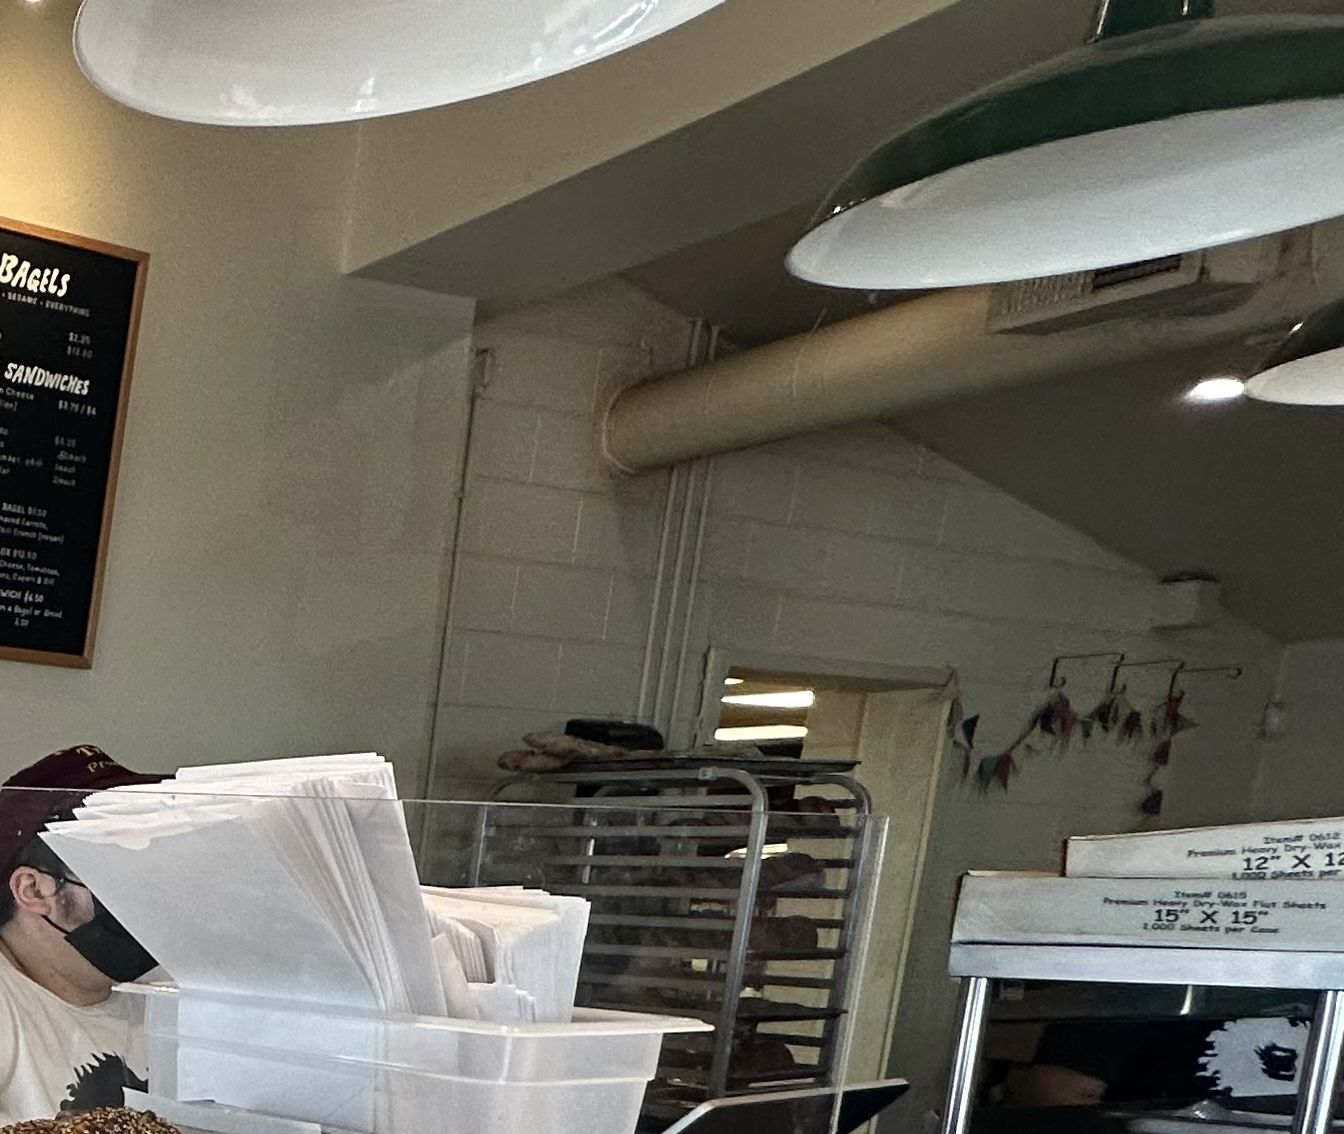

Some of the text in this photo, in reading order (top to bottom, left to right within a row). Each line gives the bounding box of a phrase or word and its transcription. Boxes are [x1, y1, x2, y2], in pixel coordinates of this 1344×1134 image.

[4, 362, 90, 396] SANDWICHES
[1263, 834, 1304, 845] Item#
[1187, 849, 1236, 857] Premium
[1241, 846, 1279, 855] Heavy
[1291, 853, 1311, 869] X
[1271, 870, 1314, 880] Sheets
[1315, 869, 1341, 879] per
[1174, 891, 1212, 899] Item#
[1103, 897, 1149, 906] Premium
[1153, 899, 1188, 908] Heavy
[1253, 900, 1277, 908] Flat
[1282, 901, 1327, 910] Sheets
[1199, 910, 1218, 924] X
[1180, 923, 1220, 933] Sheets
[1225, 926, 1245, 934] per
[1250, 926, 1279, 934] Case
